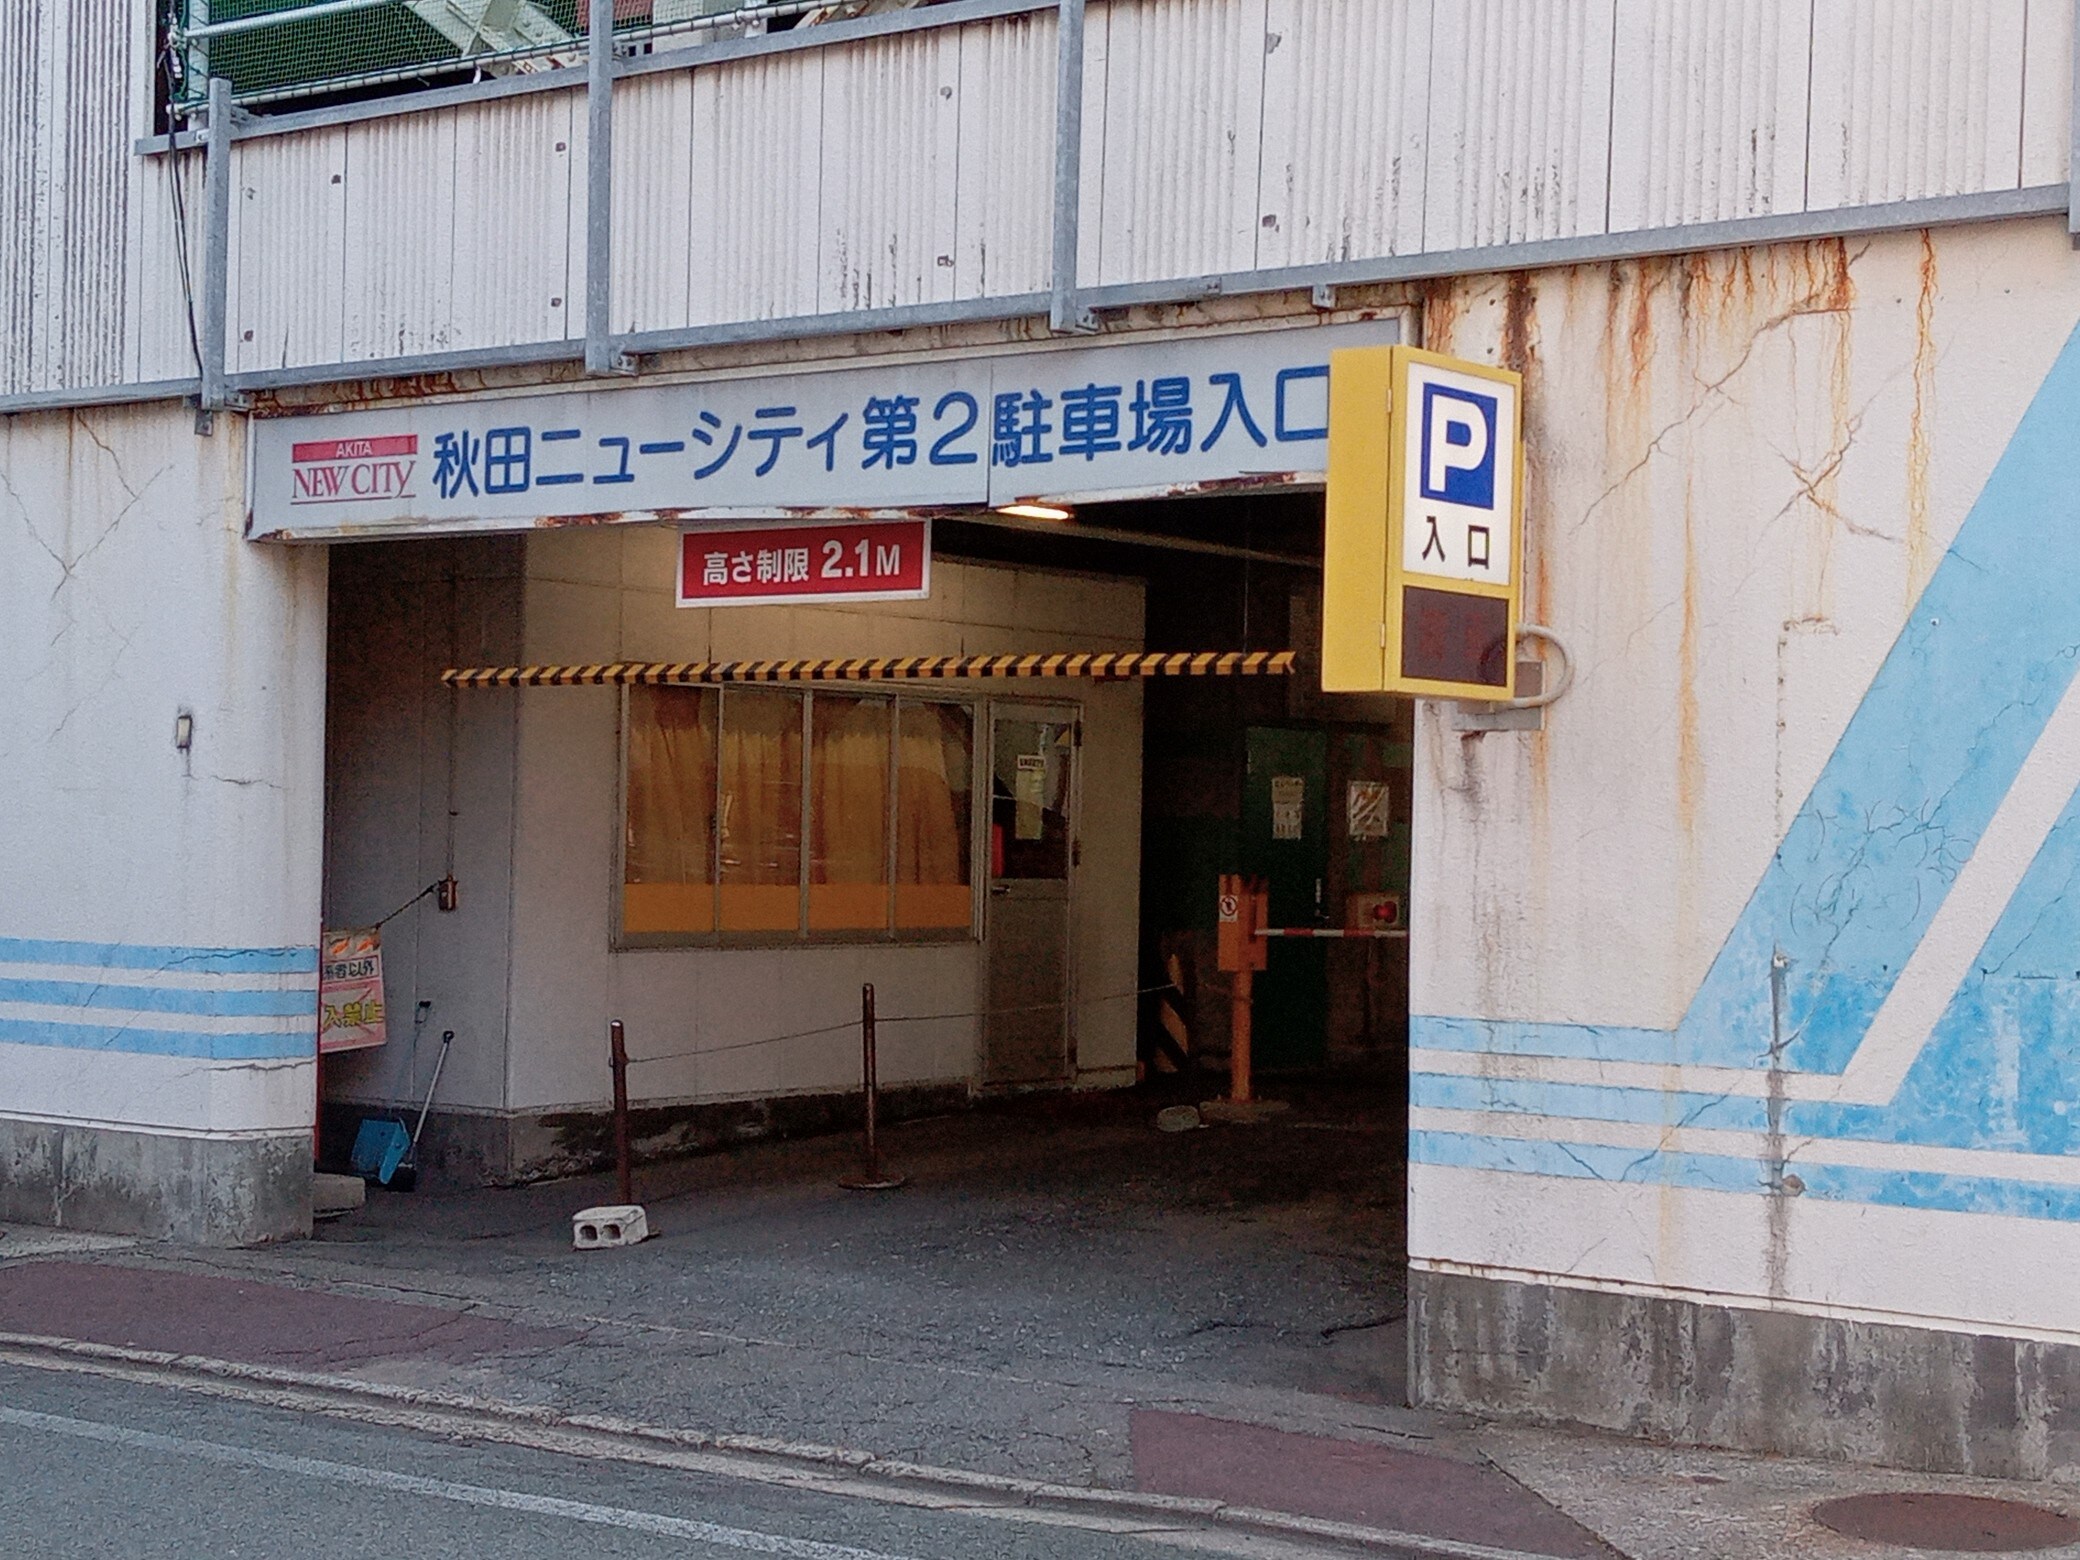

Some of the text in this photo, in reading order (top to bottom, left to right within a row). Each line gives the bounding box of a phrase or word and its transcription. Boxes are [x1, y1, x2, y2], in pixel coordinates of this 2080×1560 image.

[335, 441, 373, 458] AKITA
[1428, 393, 1488, 492] P
[292, 460, 416, 498] NEW CITY
[1422, 516, 1490, 570] 入口
[703, 548, 809, 586] 高さ制限
